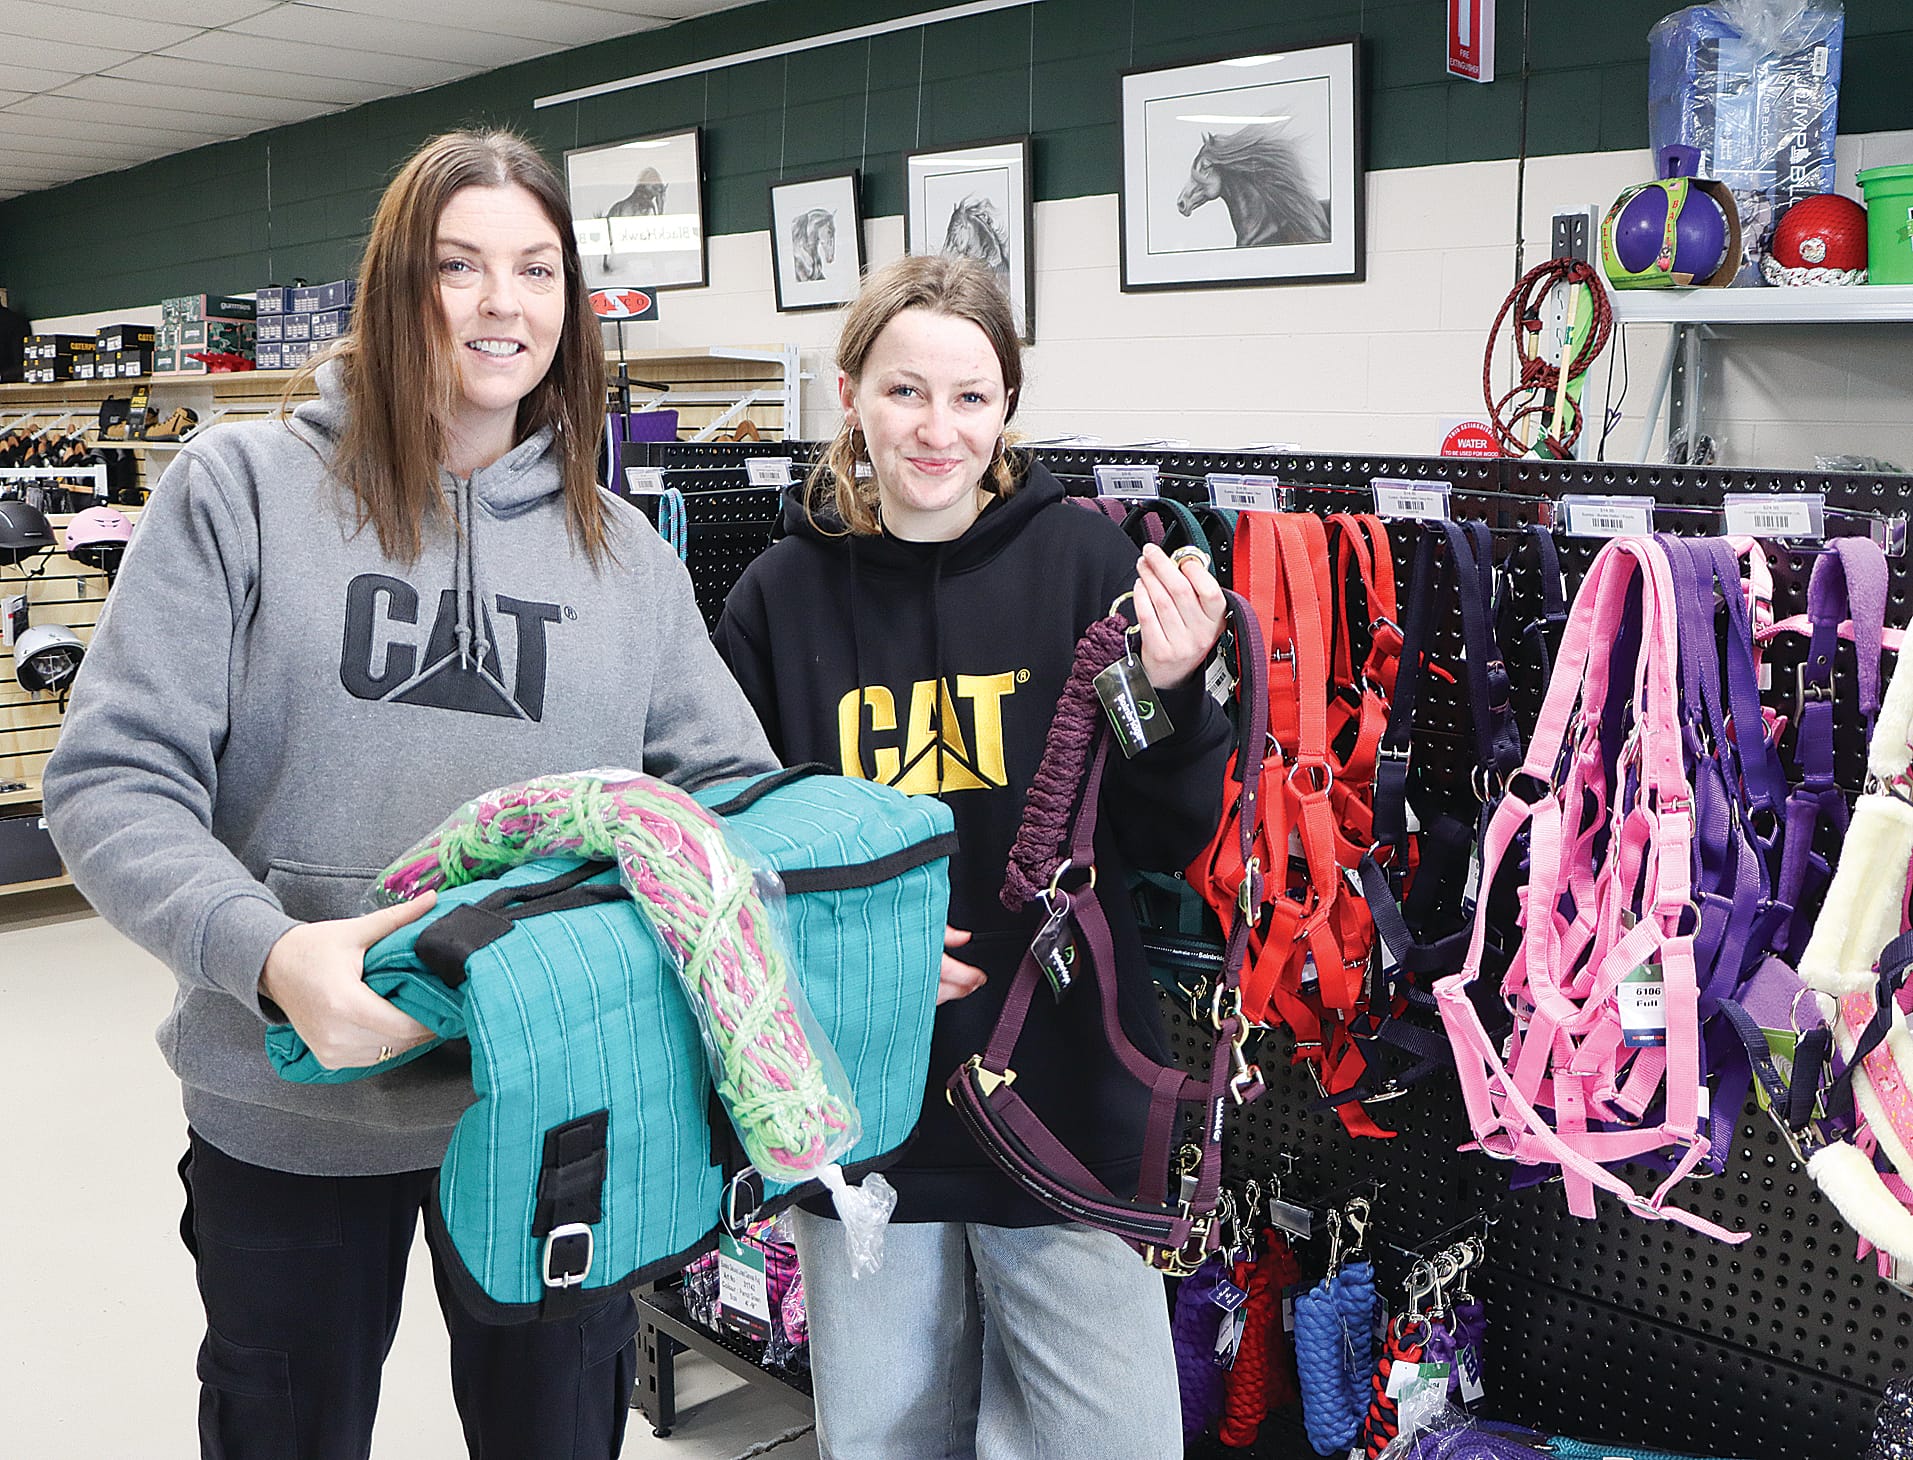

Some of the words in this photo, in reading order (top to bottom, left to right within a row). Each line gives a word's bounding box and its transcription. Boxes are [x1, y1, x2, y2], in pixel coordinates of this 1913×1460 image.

[1457, 438, 1488, 449] WATER
[340, 573, 562, 722] CAT
[838, 670, 1015, 796] CAT
[1636, 987, 1662, 996] 6106
